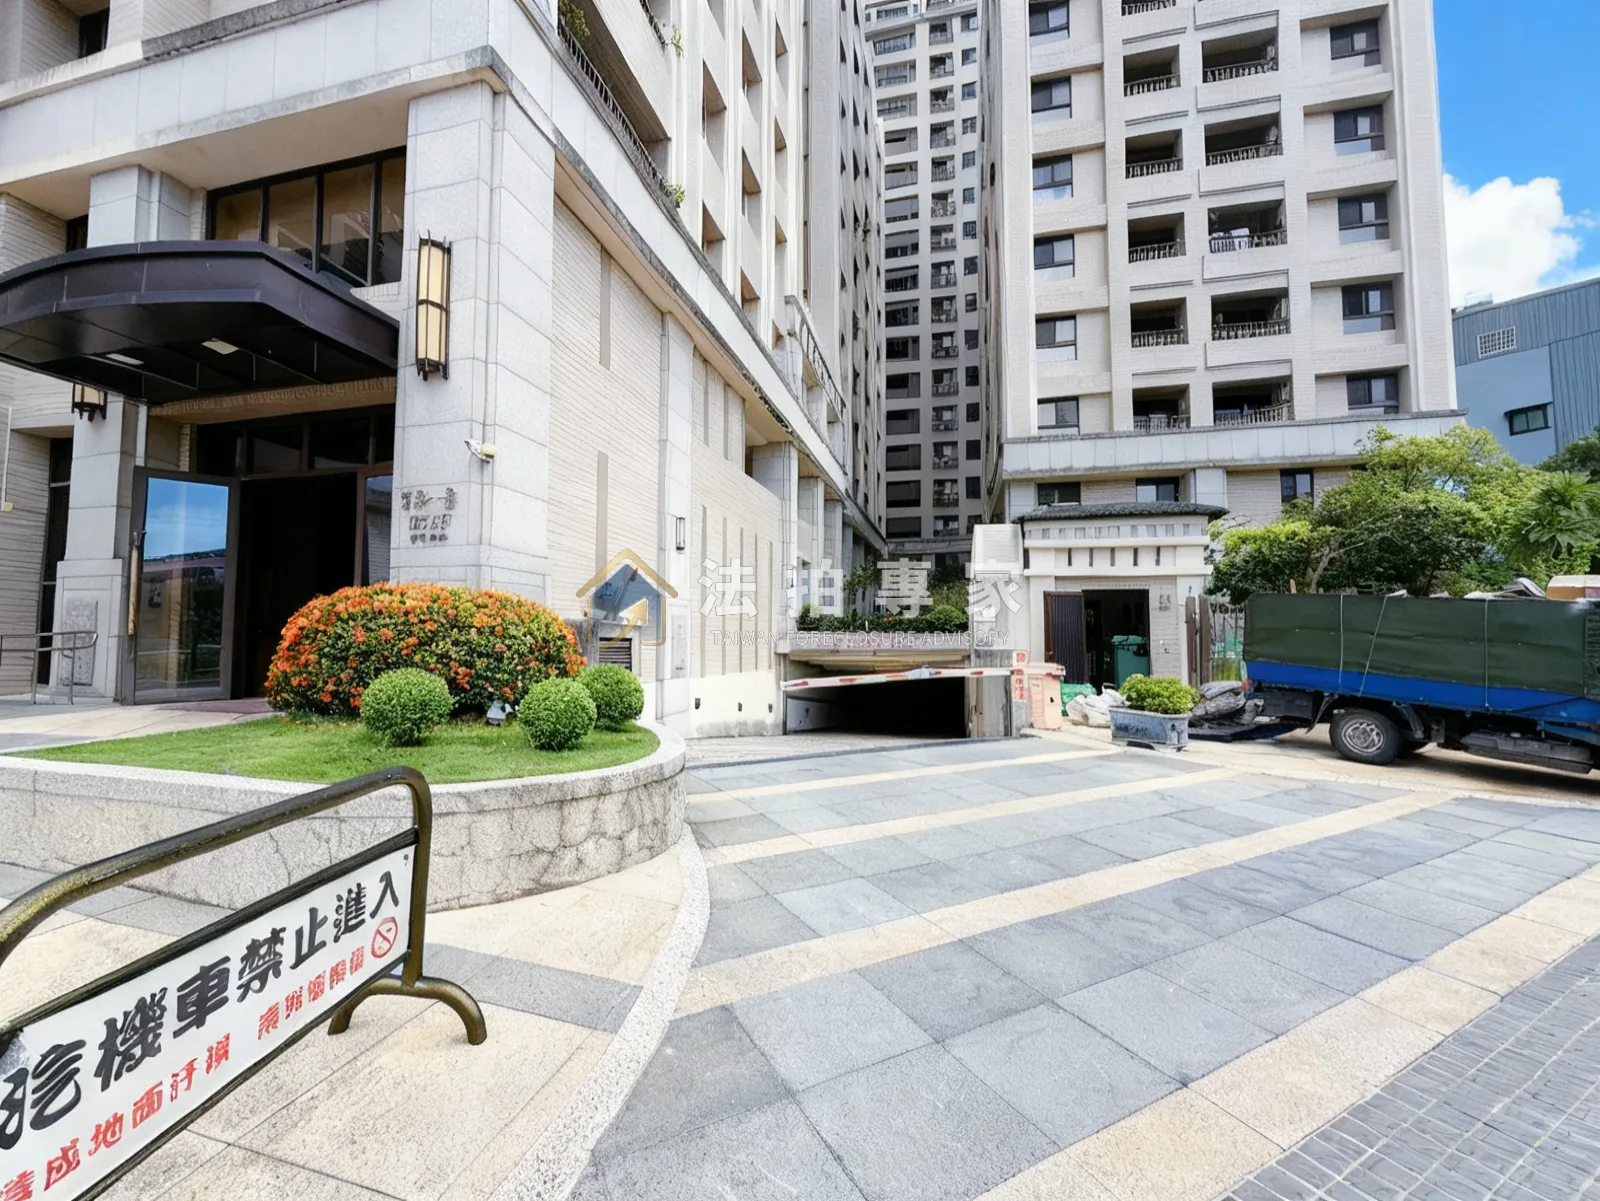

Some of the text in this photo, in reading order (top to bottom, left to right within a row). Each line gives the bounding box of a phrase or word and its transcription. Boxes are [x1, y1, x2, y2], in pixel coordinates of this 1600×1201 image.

[0, 870, 400, 1150] 汽機車禁止進入
